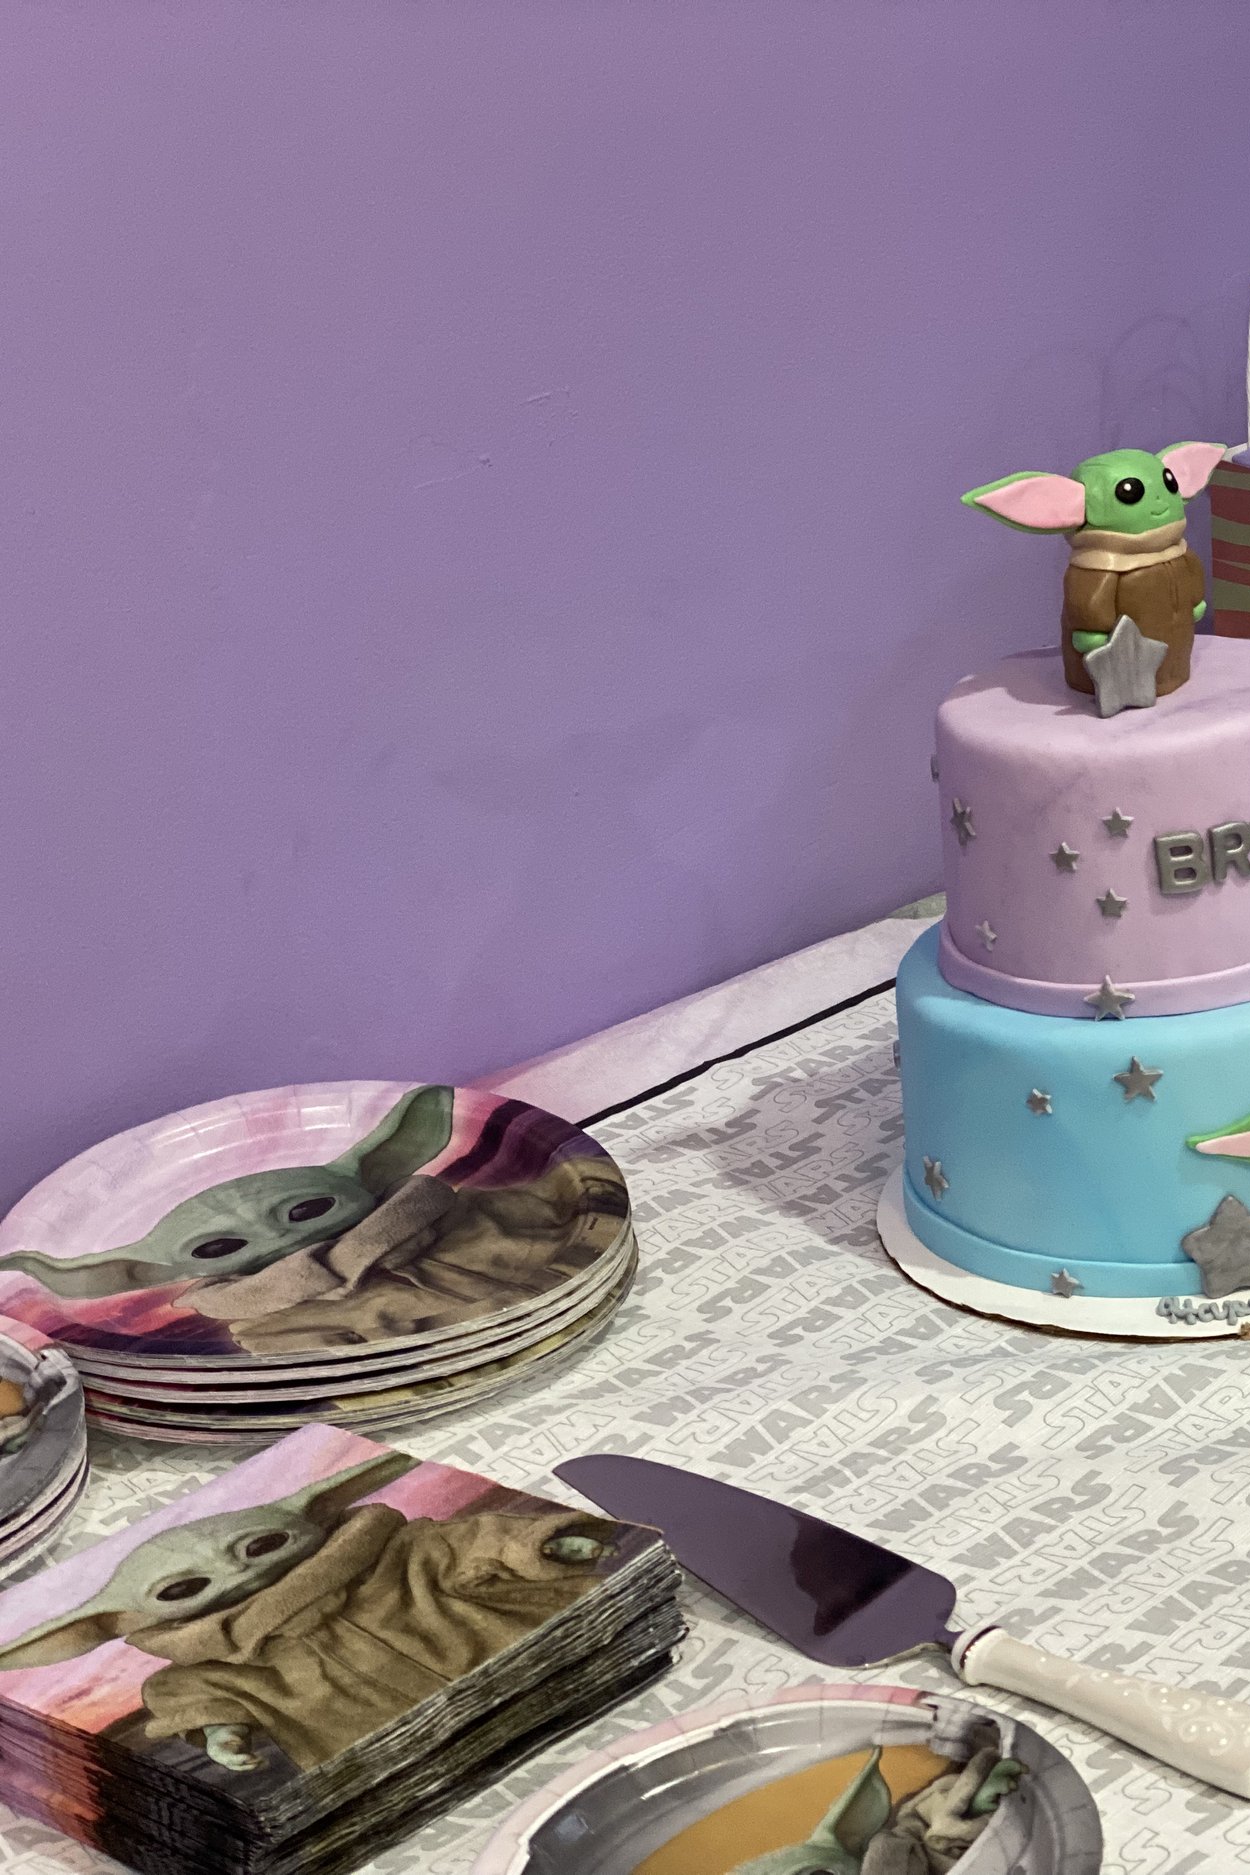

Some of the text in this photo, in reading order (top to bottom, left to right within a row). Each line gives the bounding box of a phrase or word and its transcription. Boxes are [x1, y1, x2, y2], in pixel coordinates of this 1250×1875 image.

[742, 1044, 873, 1102] STAR
[627, 1107, 762, 1163] STAR
[686, 1131, 828, 1188] STAR
[627, 1151, 895, 1296] STAR WARS
[696, 1237, 846, 1325] WARS
[556, 1327, 721, 1406] WARS
[627, 1351, 793, 1418] WARS
[447, 1402, 586, 1467] TAR
[704, 1358, 866, 1466] WARS
[783, 1394, 952, 1497] WARS
[1073, 1364, 1230, 1473] WARS
[862, 1440, 1027, 1530] WARS
[945, 1471, 1111, 1568] WARS
[1031, 1505, 1198, 1599] WARS
